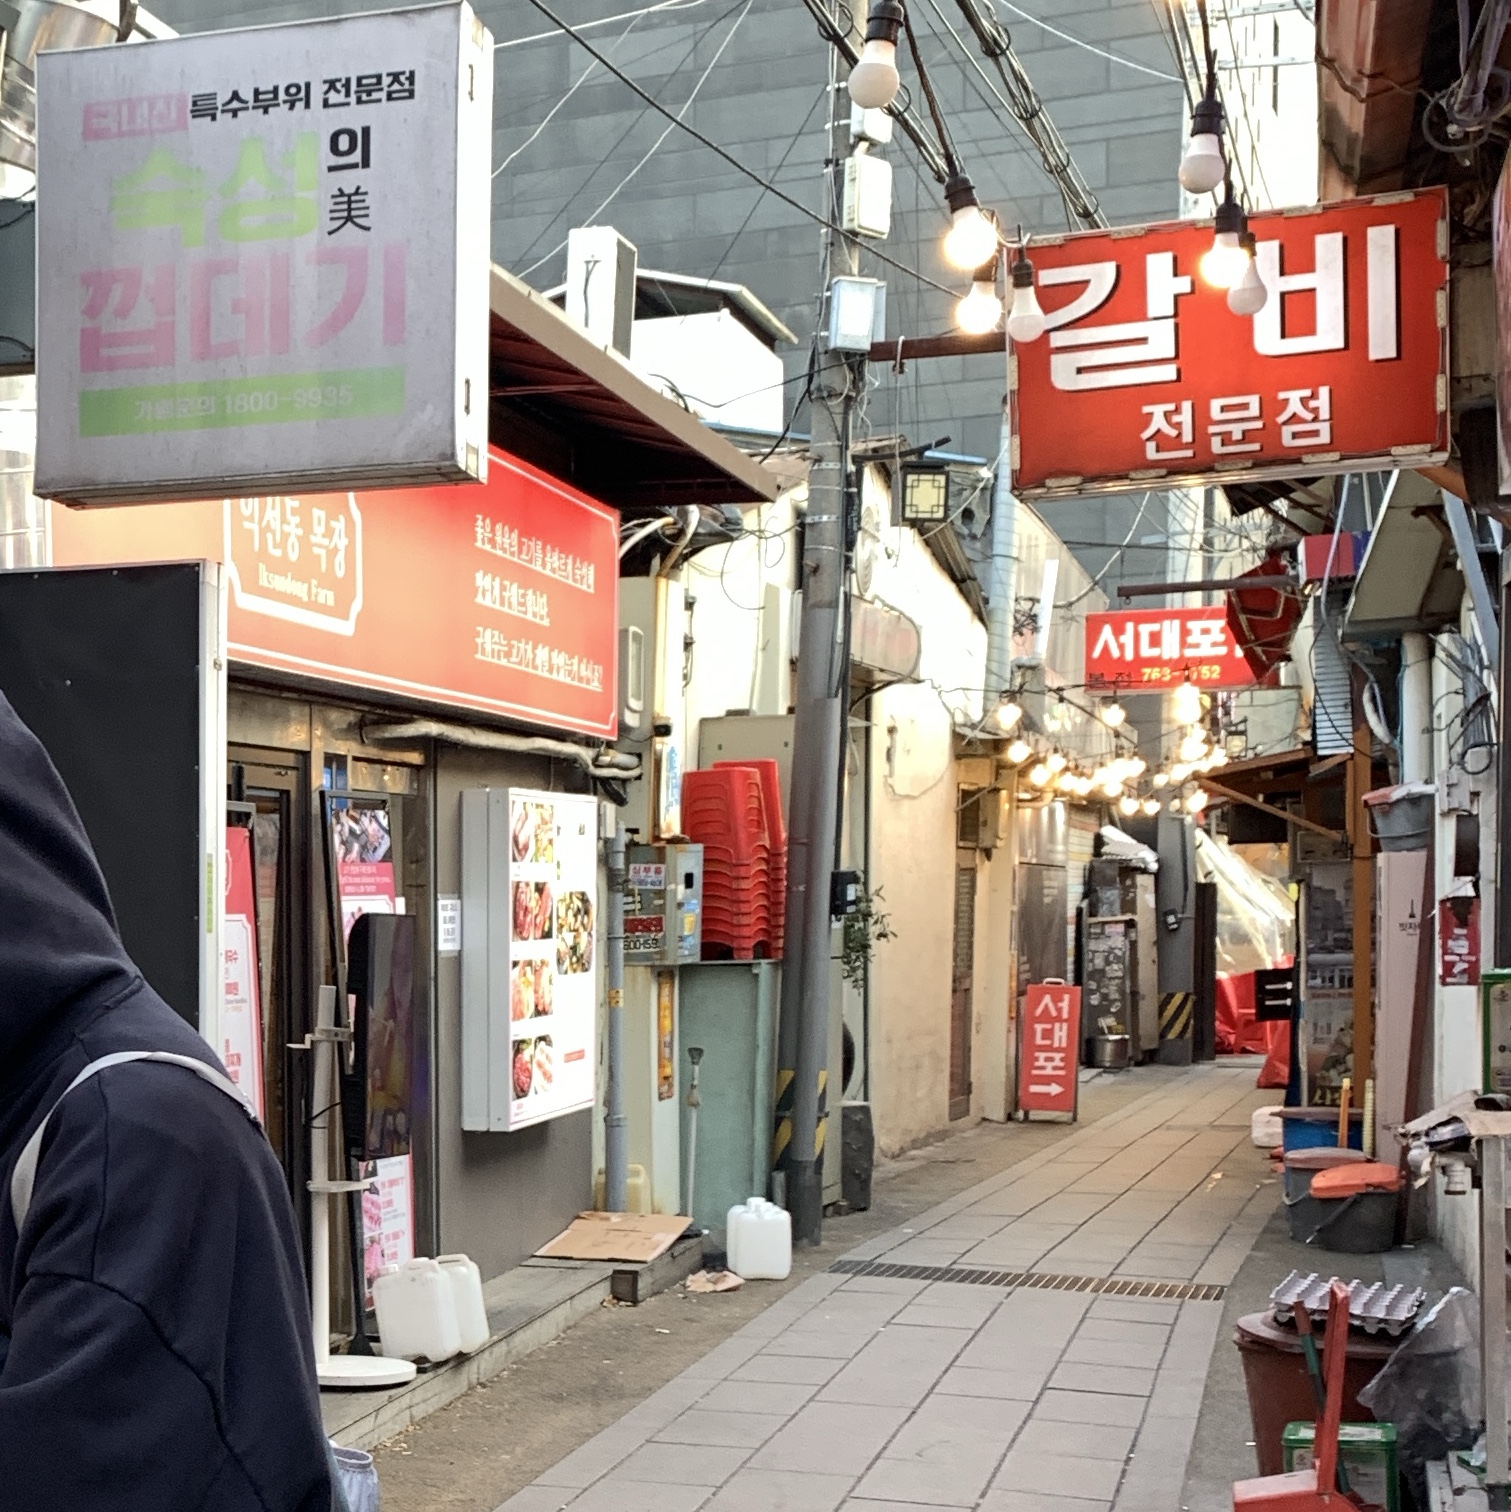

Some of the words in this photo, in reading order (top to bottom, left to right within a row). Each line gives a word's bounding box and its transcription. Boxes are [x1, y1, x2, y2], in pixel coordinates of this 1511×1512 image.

[190, 81, 311, 122] 특수부위
[322, 69, 416, 110] 전문점
[107, 129, 320, 248] 숙성
[78, 241, 406, 374] 껍데기
[1038, 223, 1400, 392] 갈비
[1140, 384, 1335, 462] 전문점
[309, 507, 349, 579] 목장
[1030, 993, 1070, 1076] 서대포
